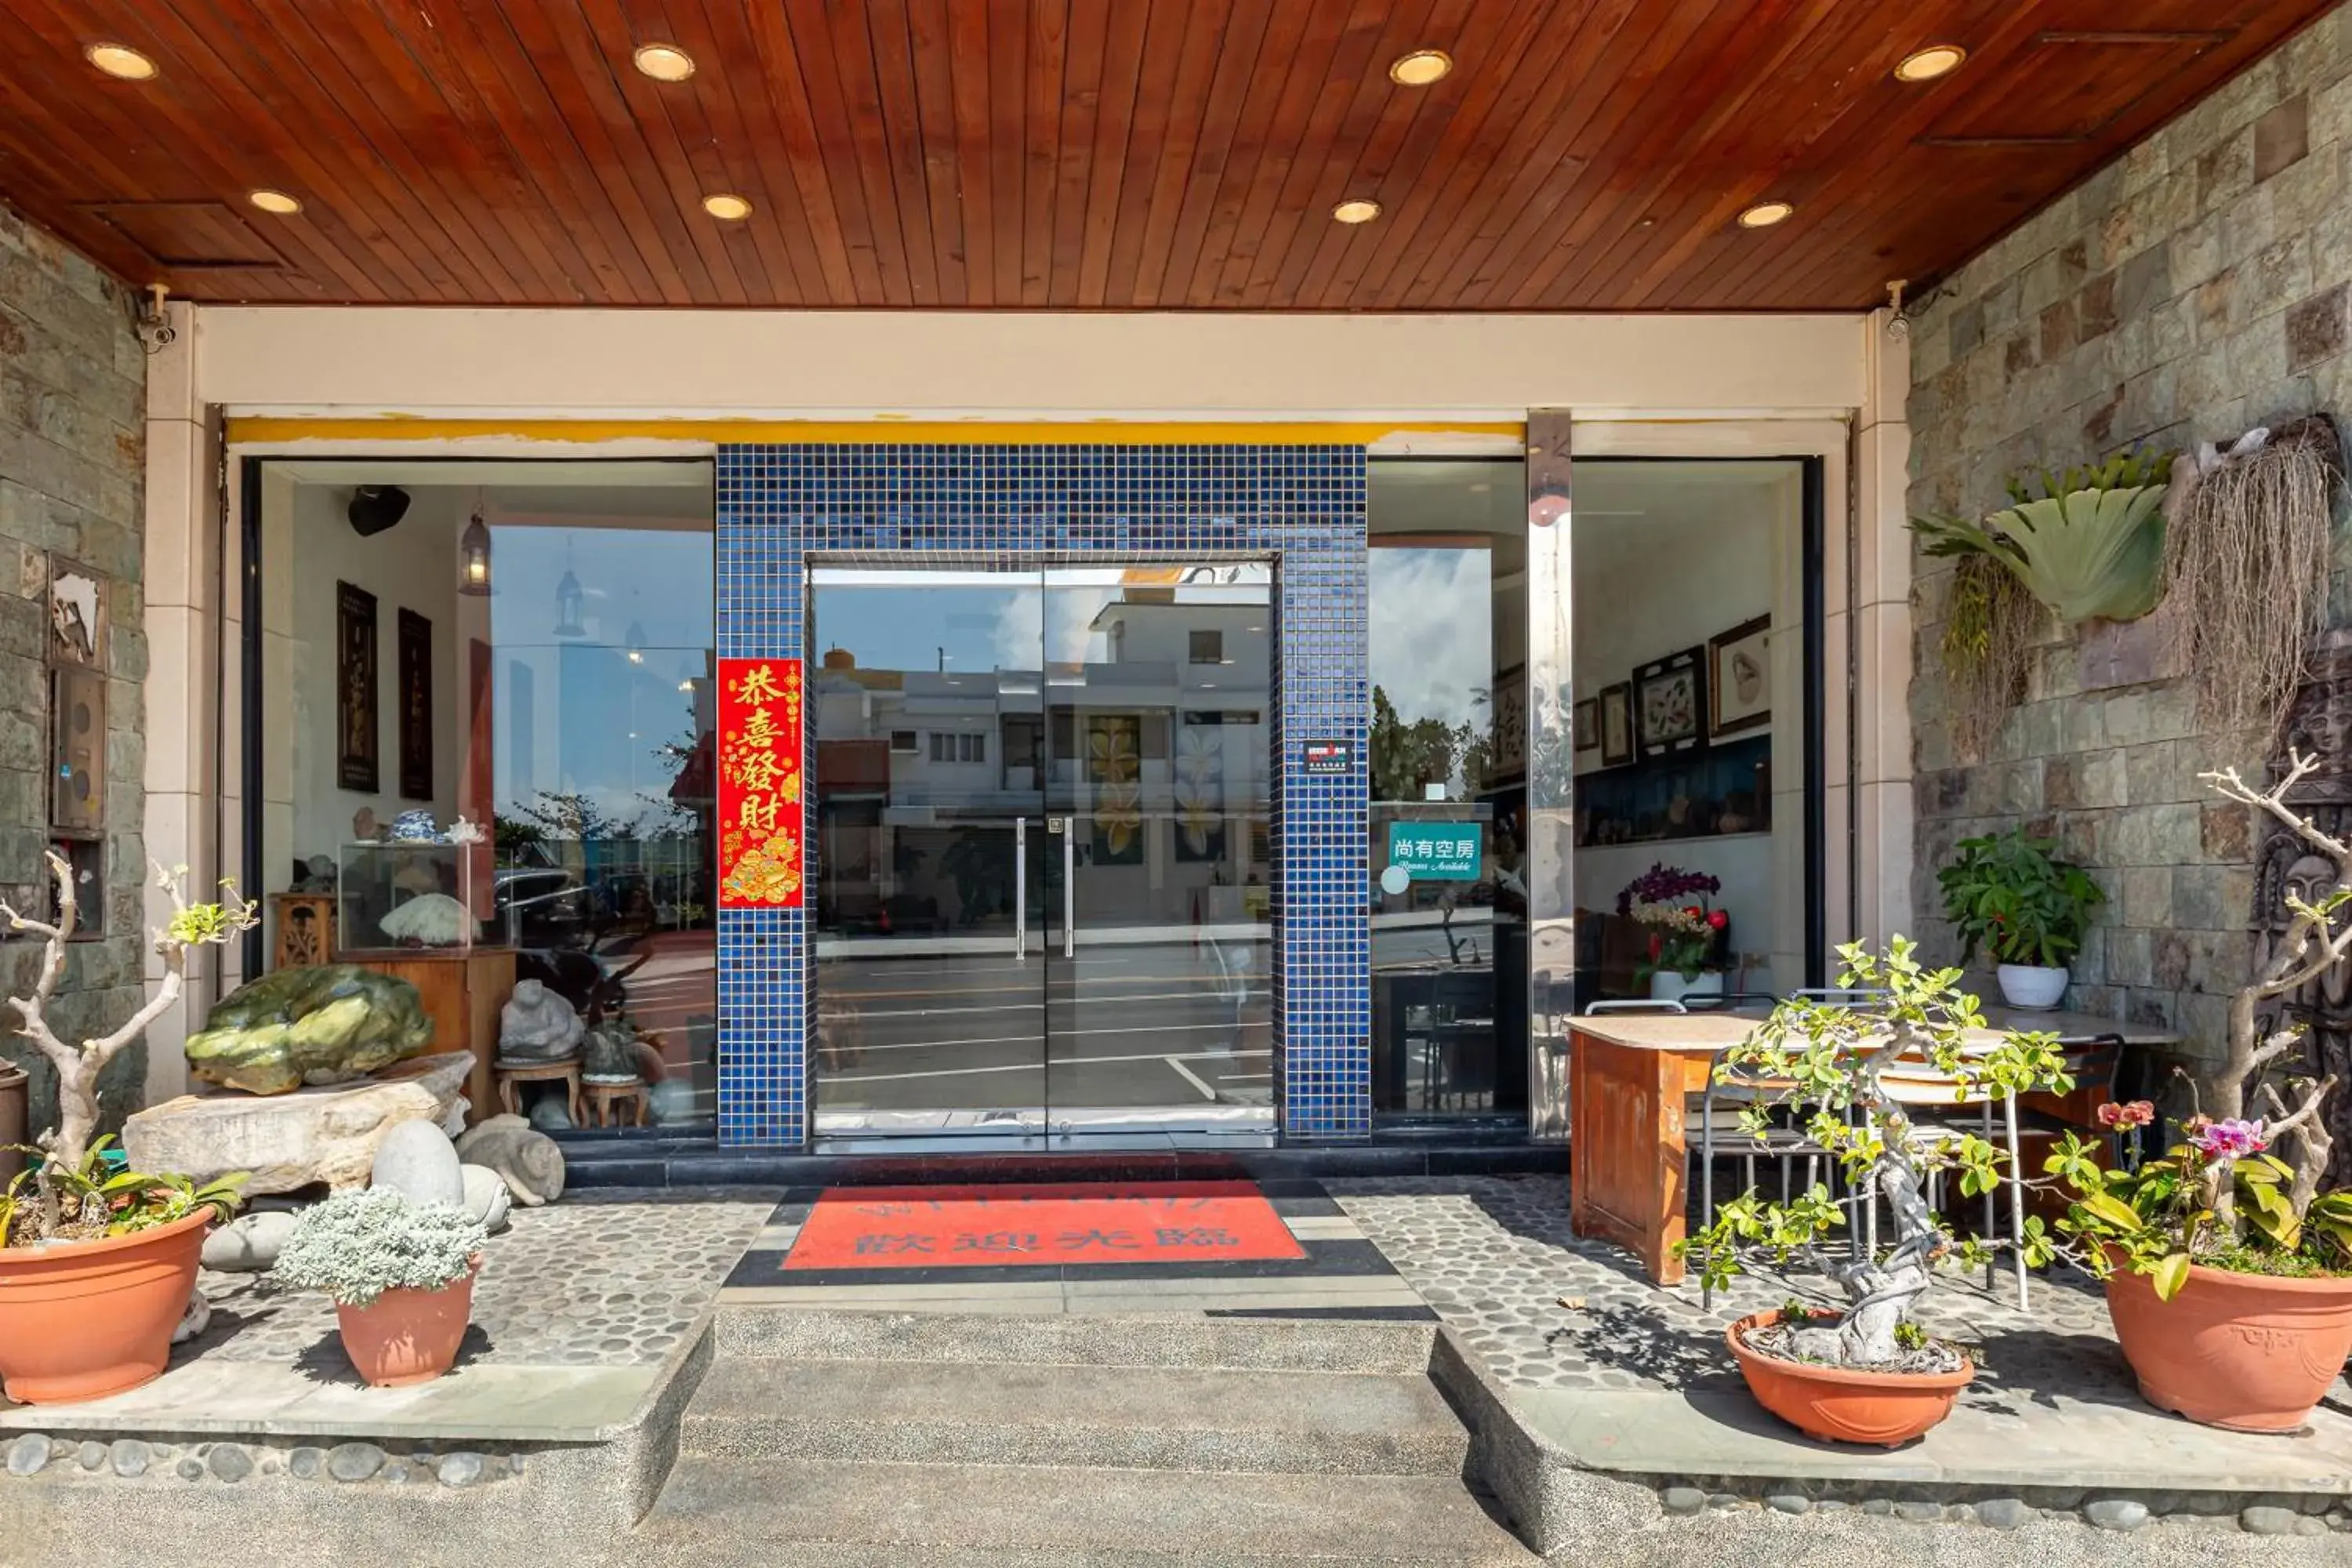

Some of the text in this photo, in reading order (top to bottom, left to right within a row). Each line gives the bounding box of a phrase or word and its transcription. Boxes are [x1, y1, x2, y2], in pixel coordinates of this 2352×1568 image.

[735, 664, 787, 831] 恭喜發財
[1395, 839, 1475, 858] 尚有空房
